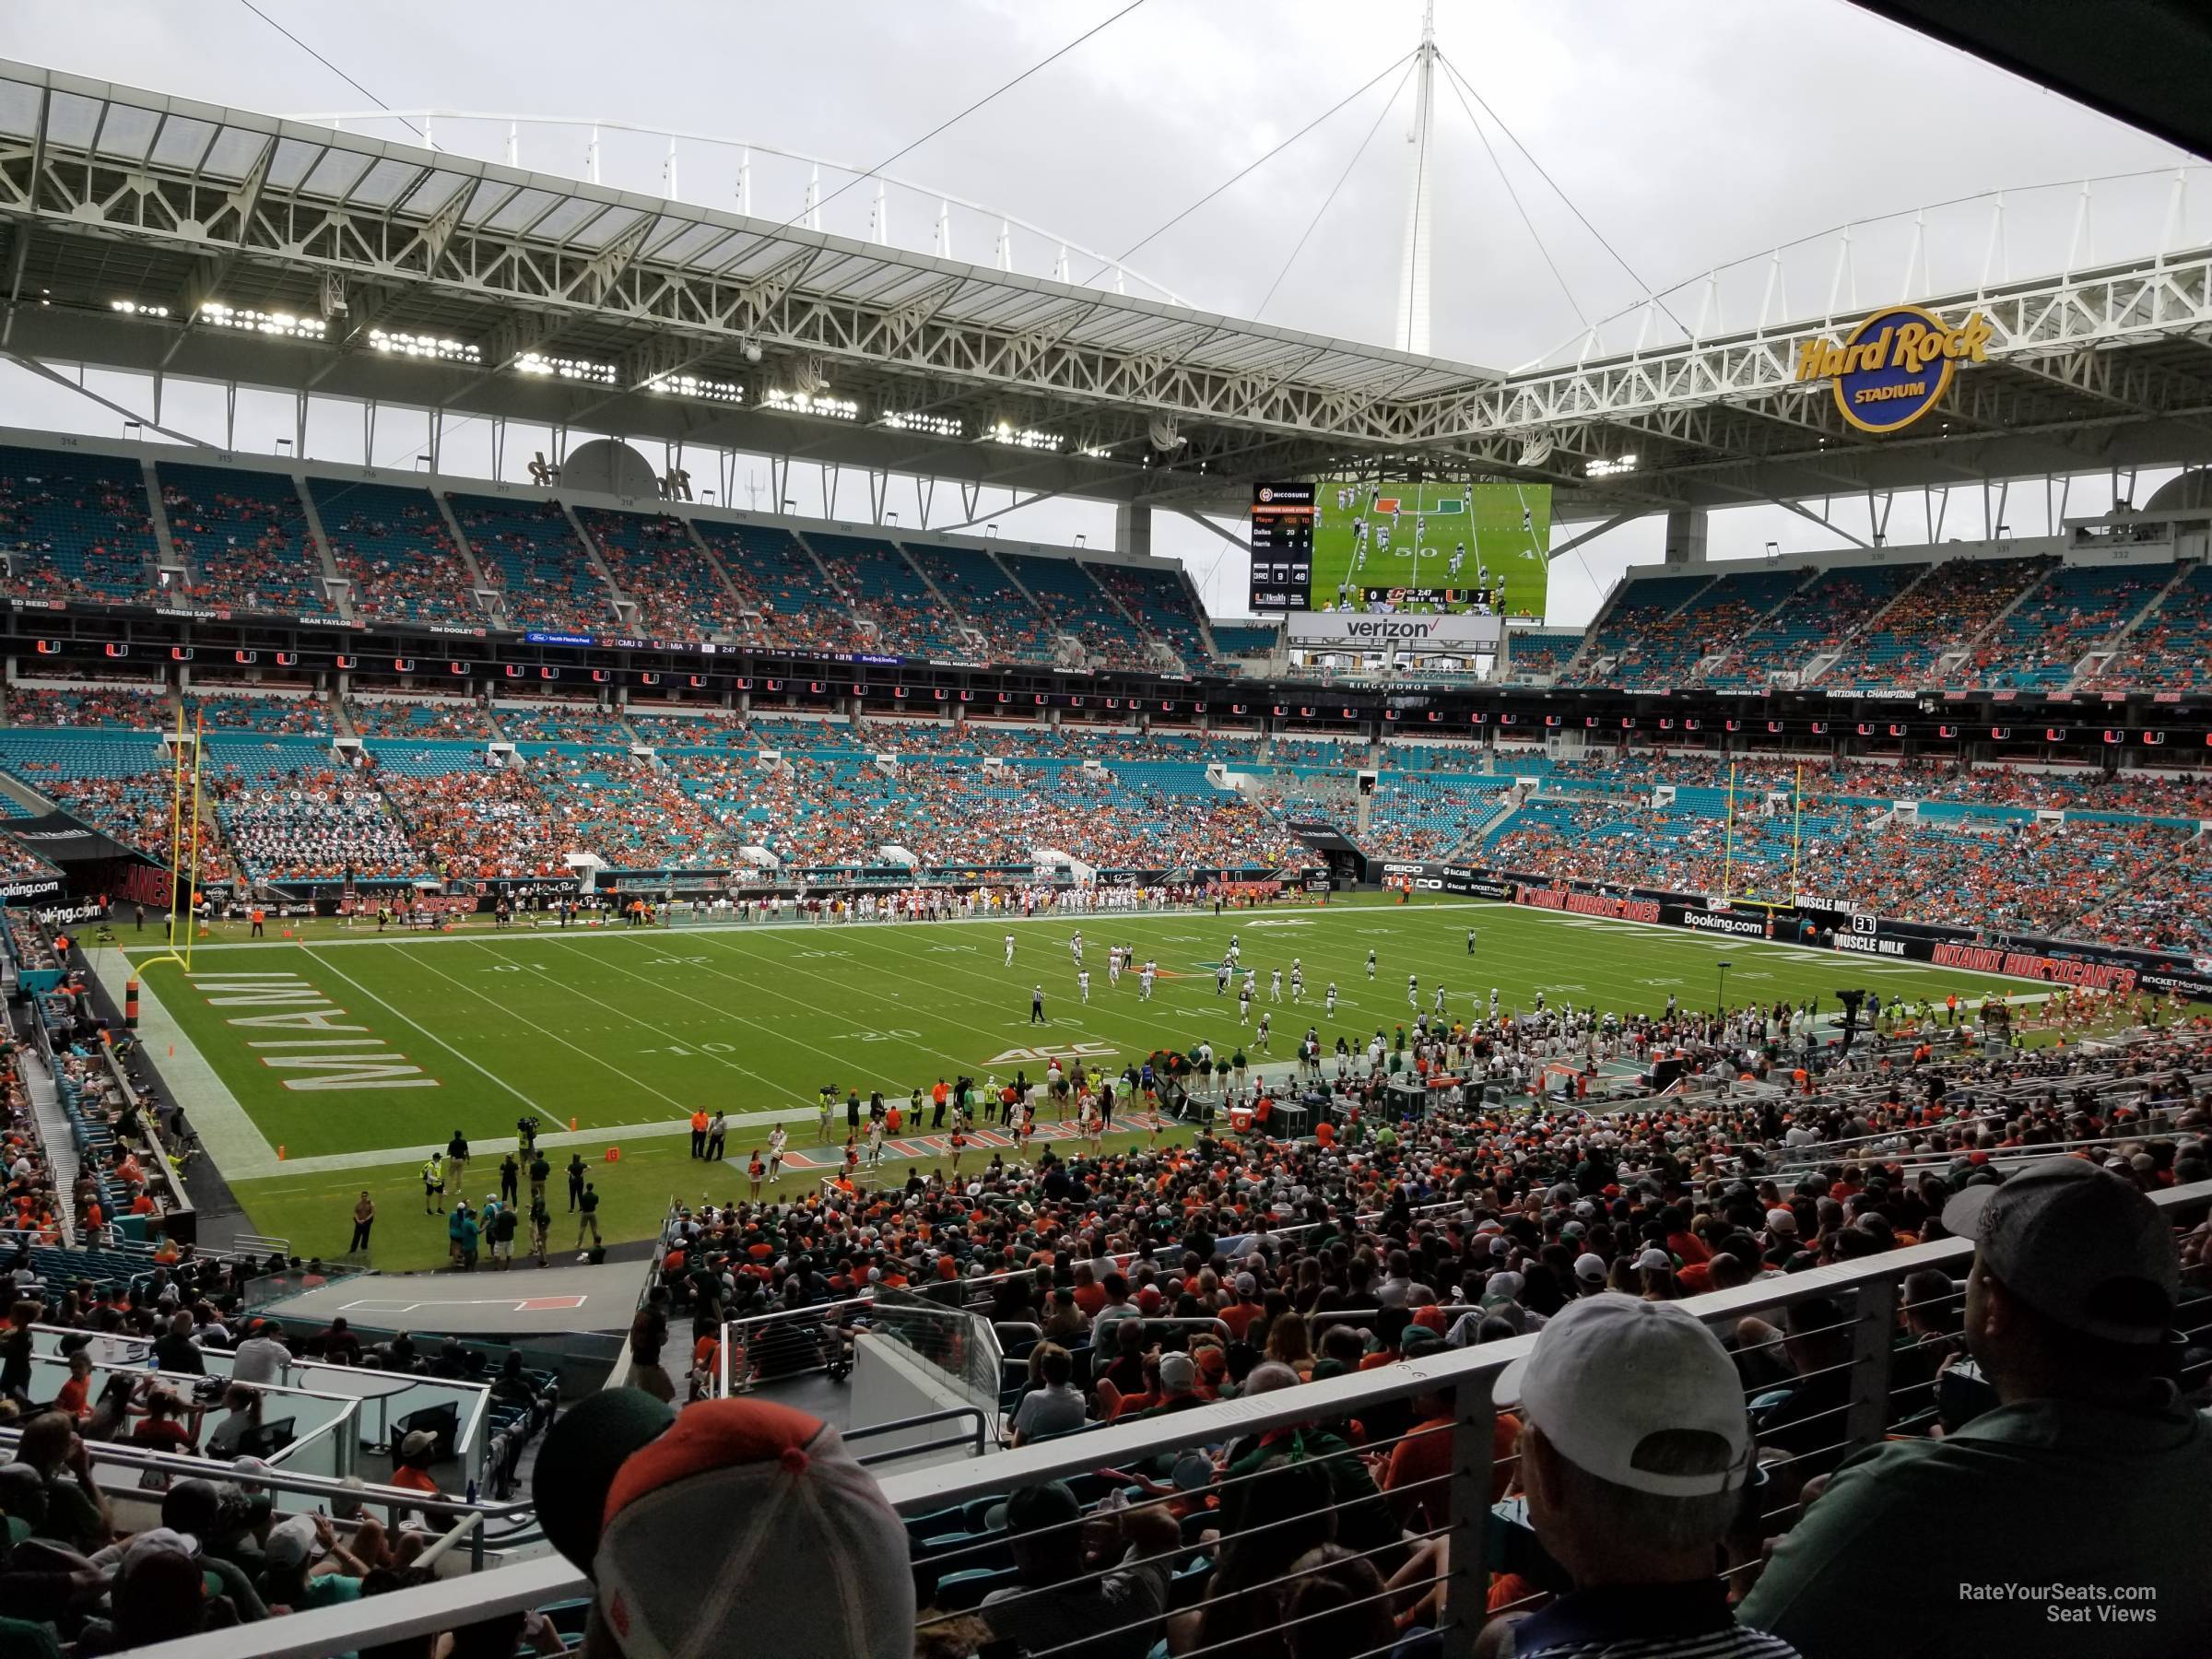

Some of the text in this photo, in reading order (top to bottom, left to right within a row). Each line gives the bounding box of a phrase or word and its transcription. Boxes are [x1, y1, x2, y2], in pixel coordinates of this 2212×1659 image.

[1794, 312, 1992, 381] Hard Rock
[1854, 382, 1925, 404] STADIUM
[1370, 591, 1377, 600] 0
[1477, 593, 1484, 602] 7
[25, 600, 49, 608] REED
[156, 607, 216, 618] WARREN SAPP
[300, 617, 321, 625] SEAN
[322, 618, 351, 627] TAYLOR
[1347, 618, 1428, 637] verizon
[444, 627, 473, 635] DOOLEY
[1349, 682, 1377, 690] RING
[1388, 683, 1429, 691] HONOR
[1826, 690, 1916, 700] NATIONAL CHAMPIONS
[1383, 865, 1423, 873] GEICO
[1795, 895, 1859, 913] MUSCLE MILK
[1684, 912, 1762, 935] Booking.com
[1857, 919, 1874, 930] 37
[1834, 934, 1907, 955] MUSCLE MILK
[1932, 943, 2004, 972] MIAMI
[2142, 975, 2178, 987] ROCKET
[184, 972, 443, 1090] MIAMI
[851, 1029, 922, 1041] 20
[665, 1042, 736, 1056] 10
[986, 1041, 1114, 1063] ACC
[1235, 1116, 1246, 1127] G
[610, 1148, 618, 1159] G
